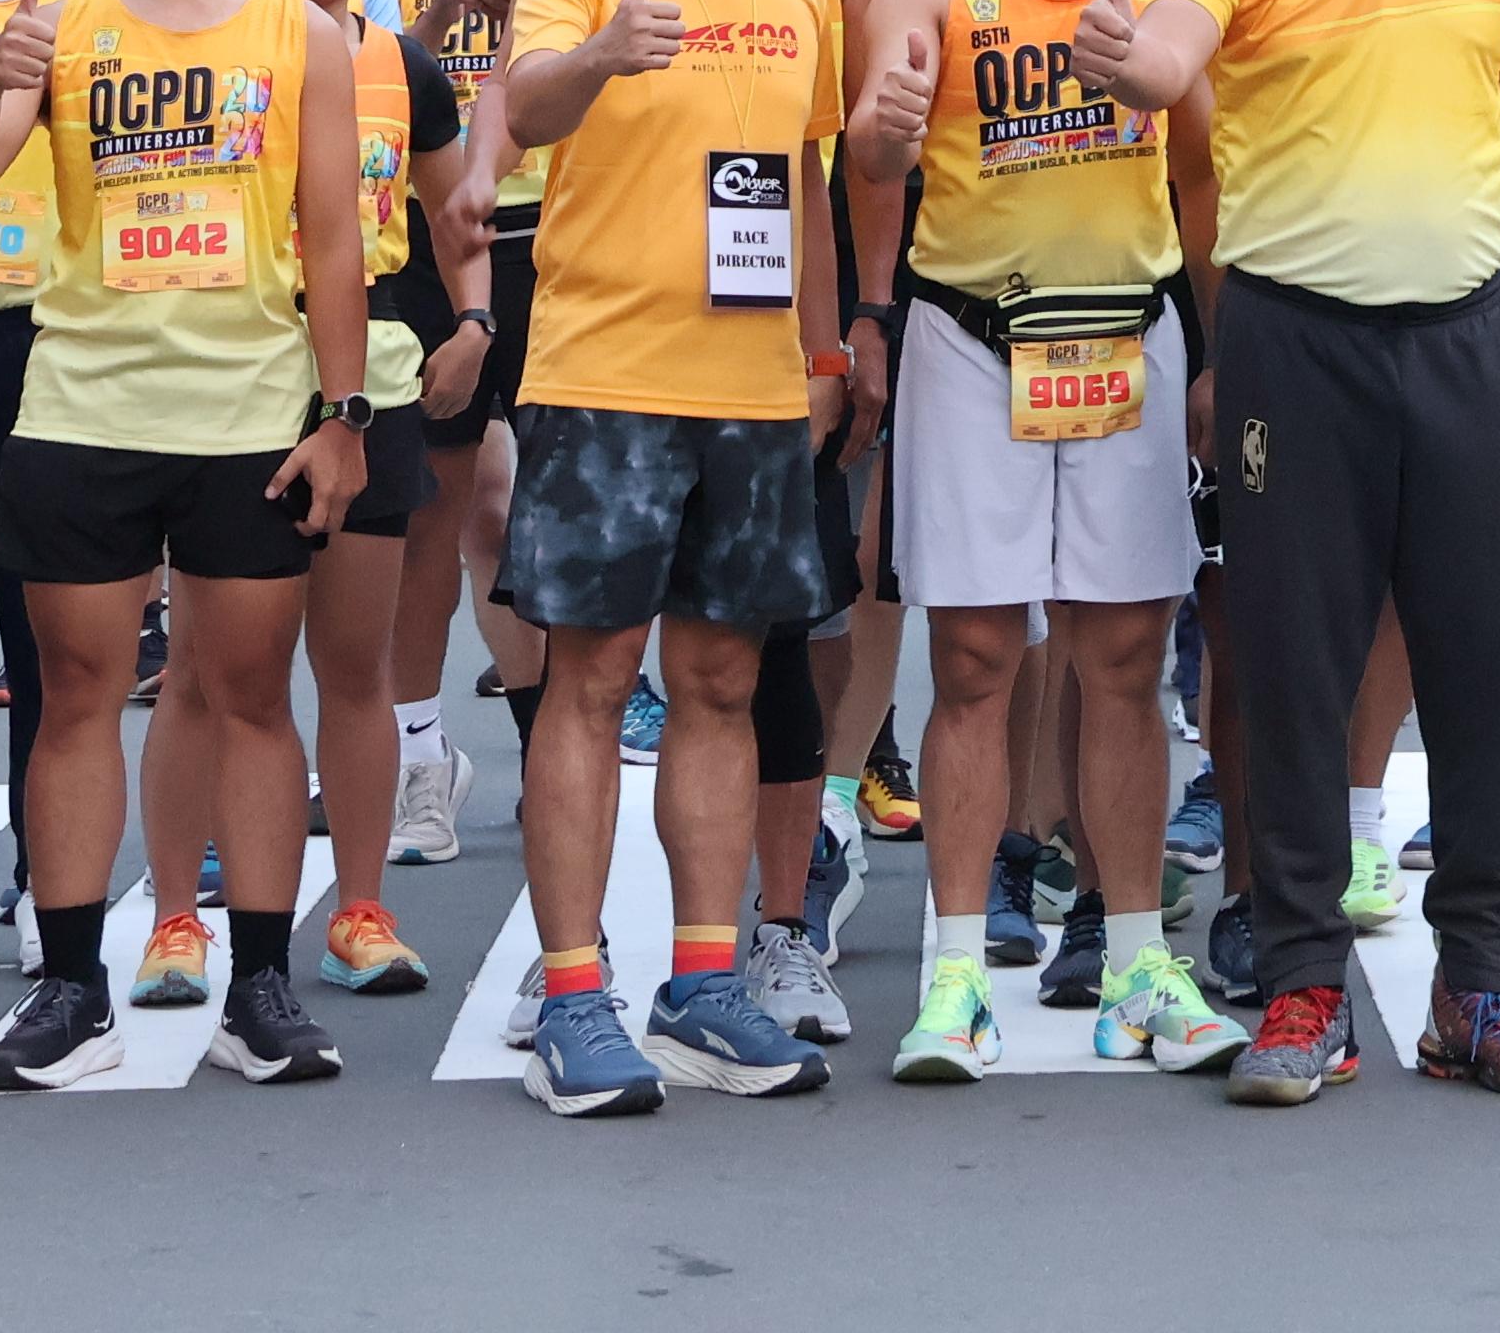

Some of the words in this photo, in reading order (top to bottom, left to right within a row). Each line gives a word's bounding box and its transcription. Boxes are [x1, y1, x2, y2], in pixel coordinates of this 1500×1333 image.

[971, 26, 1010, 49] 85TH
[90, 58, 122, 77] 85TH
[974, 42, 1109, 121] QCP
[89, 66, 215, 137] QCPD
[987, 106, 1108, 141] ANNIVERSARY
[99, 128, 206, 157] ANNIVERSARY
[137, 192, 169, 210] QCPD
[119, 222, 228, 261] 9042
[732, 230, 769, 245] RACE
[716, 254, 786, 269] DIRECTOR
[1047, 346, 1079, 359] QCPD
[1029, 371, 1130, 409] 9069
